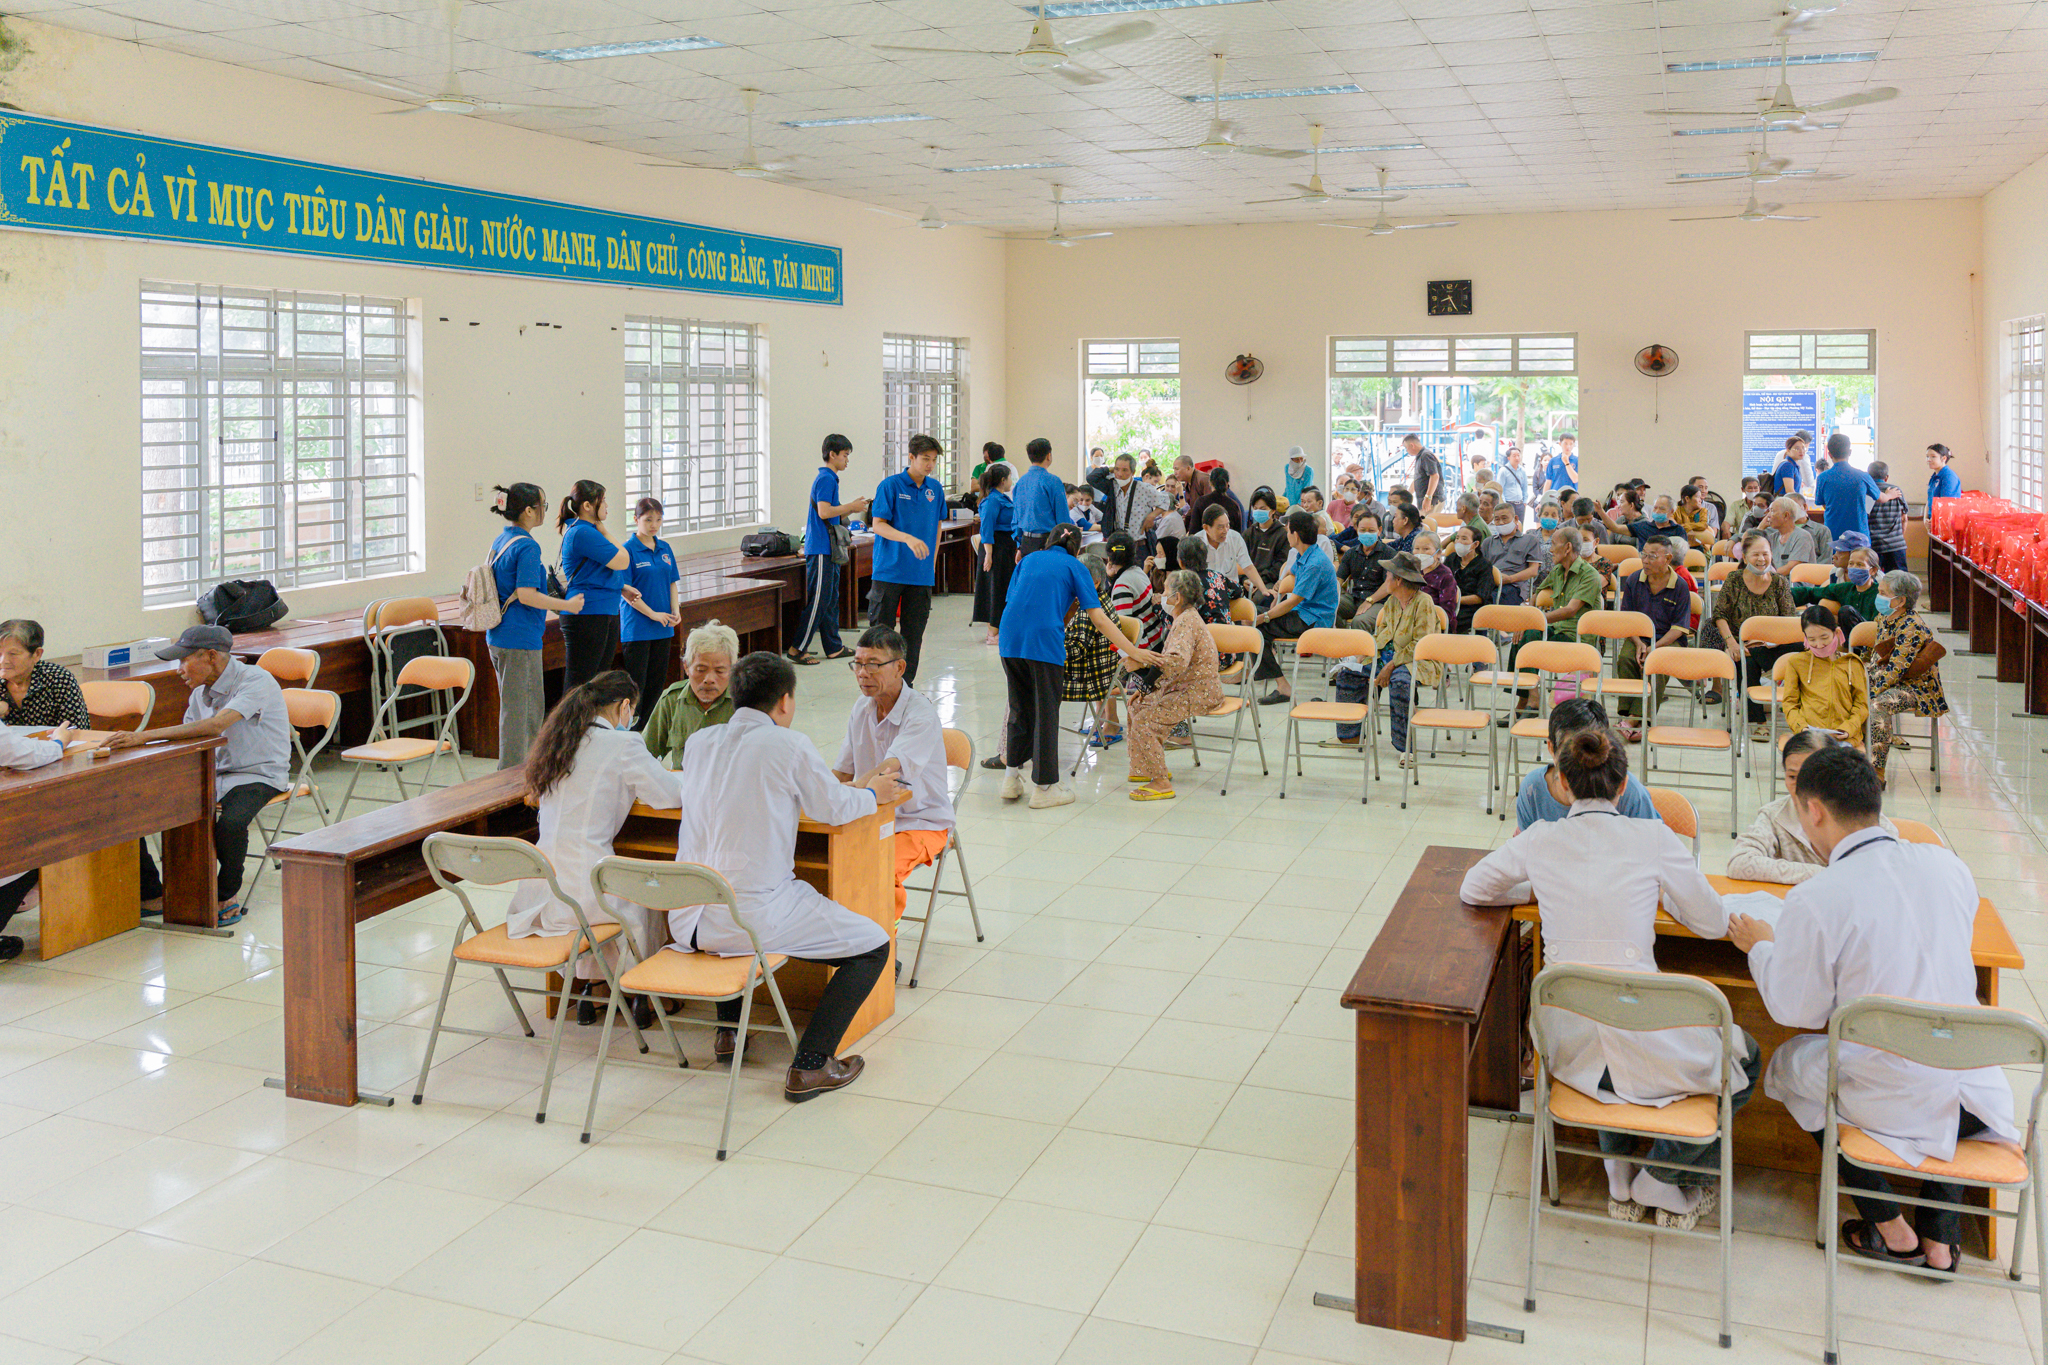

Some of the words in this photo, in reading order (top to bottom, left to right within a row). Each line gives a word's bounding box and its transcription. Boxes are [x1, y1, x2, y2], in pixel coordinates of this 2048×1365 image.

[21, 137, 94, 210] TẤT
[108, 153, 154, 217] CẢ
[163, 165, 197, 222] VÌ
[207, 182, 274, 239] MỤC
[283, 185, 346, 239] TIÊU
[355, 194, 405, 245] DÂN
[414, 203, 473, 258] GIÀU,
[482, 214, 536, 260] NƯỚC
[543, 229, 600, 273] MẠNH,
[607, 230, 641, 271] DÂN
[647, 234, 682, 280] CHỦ,
[688, 241, 726, 281] CÔNG
[731, 240, 769, 289] BẰNG,
[773, 254, 797, 288] VĂN
[801, 264, 834, 292] MINH!
